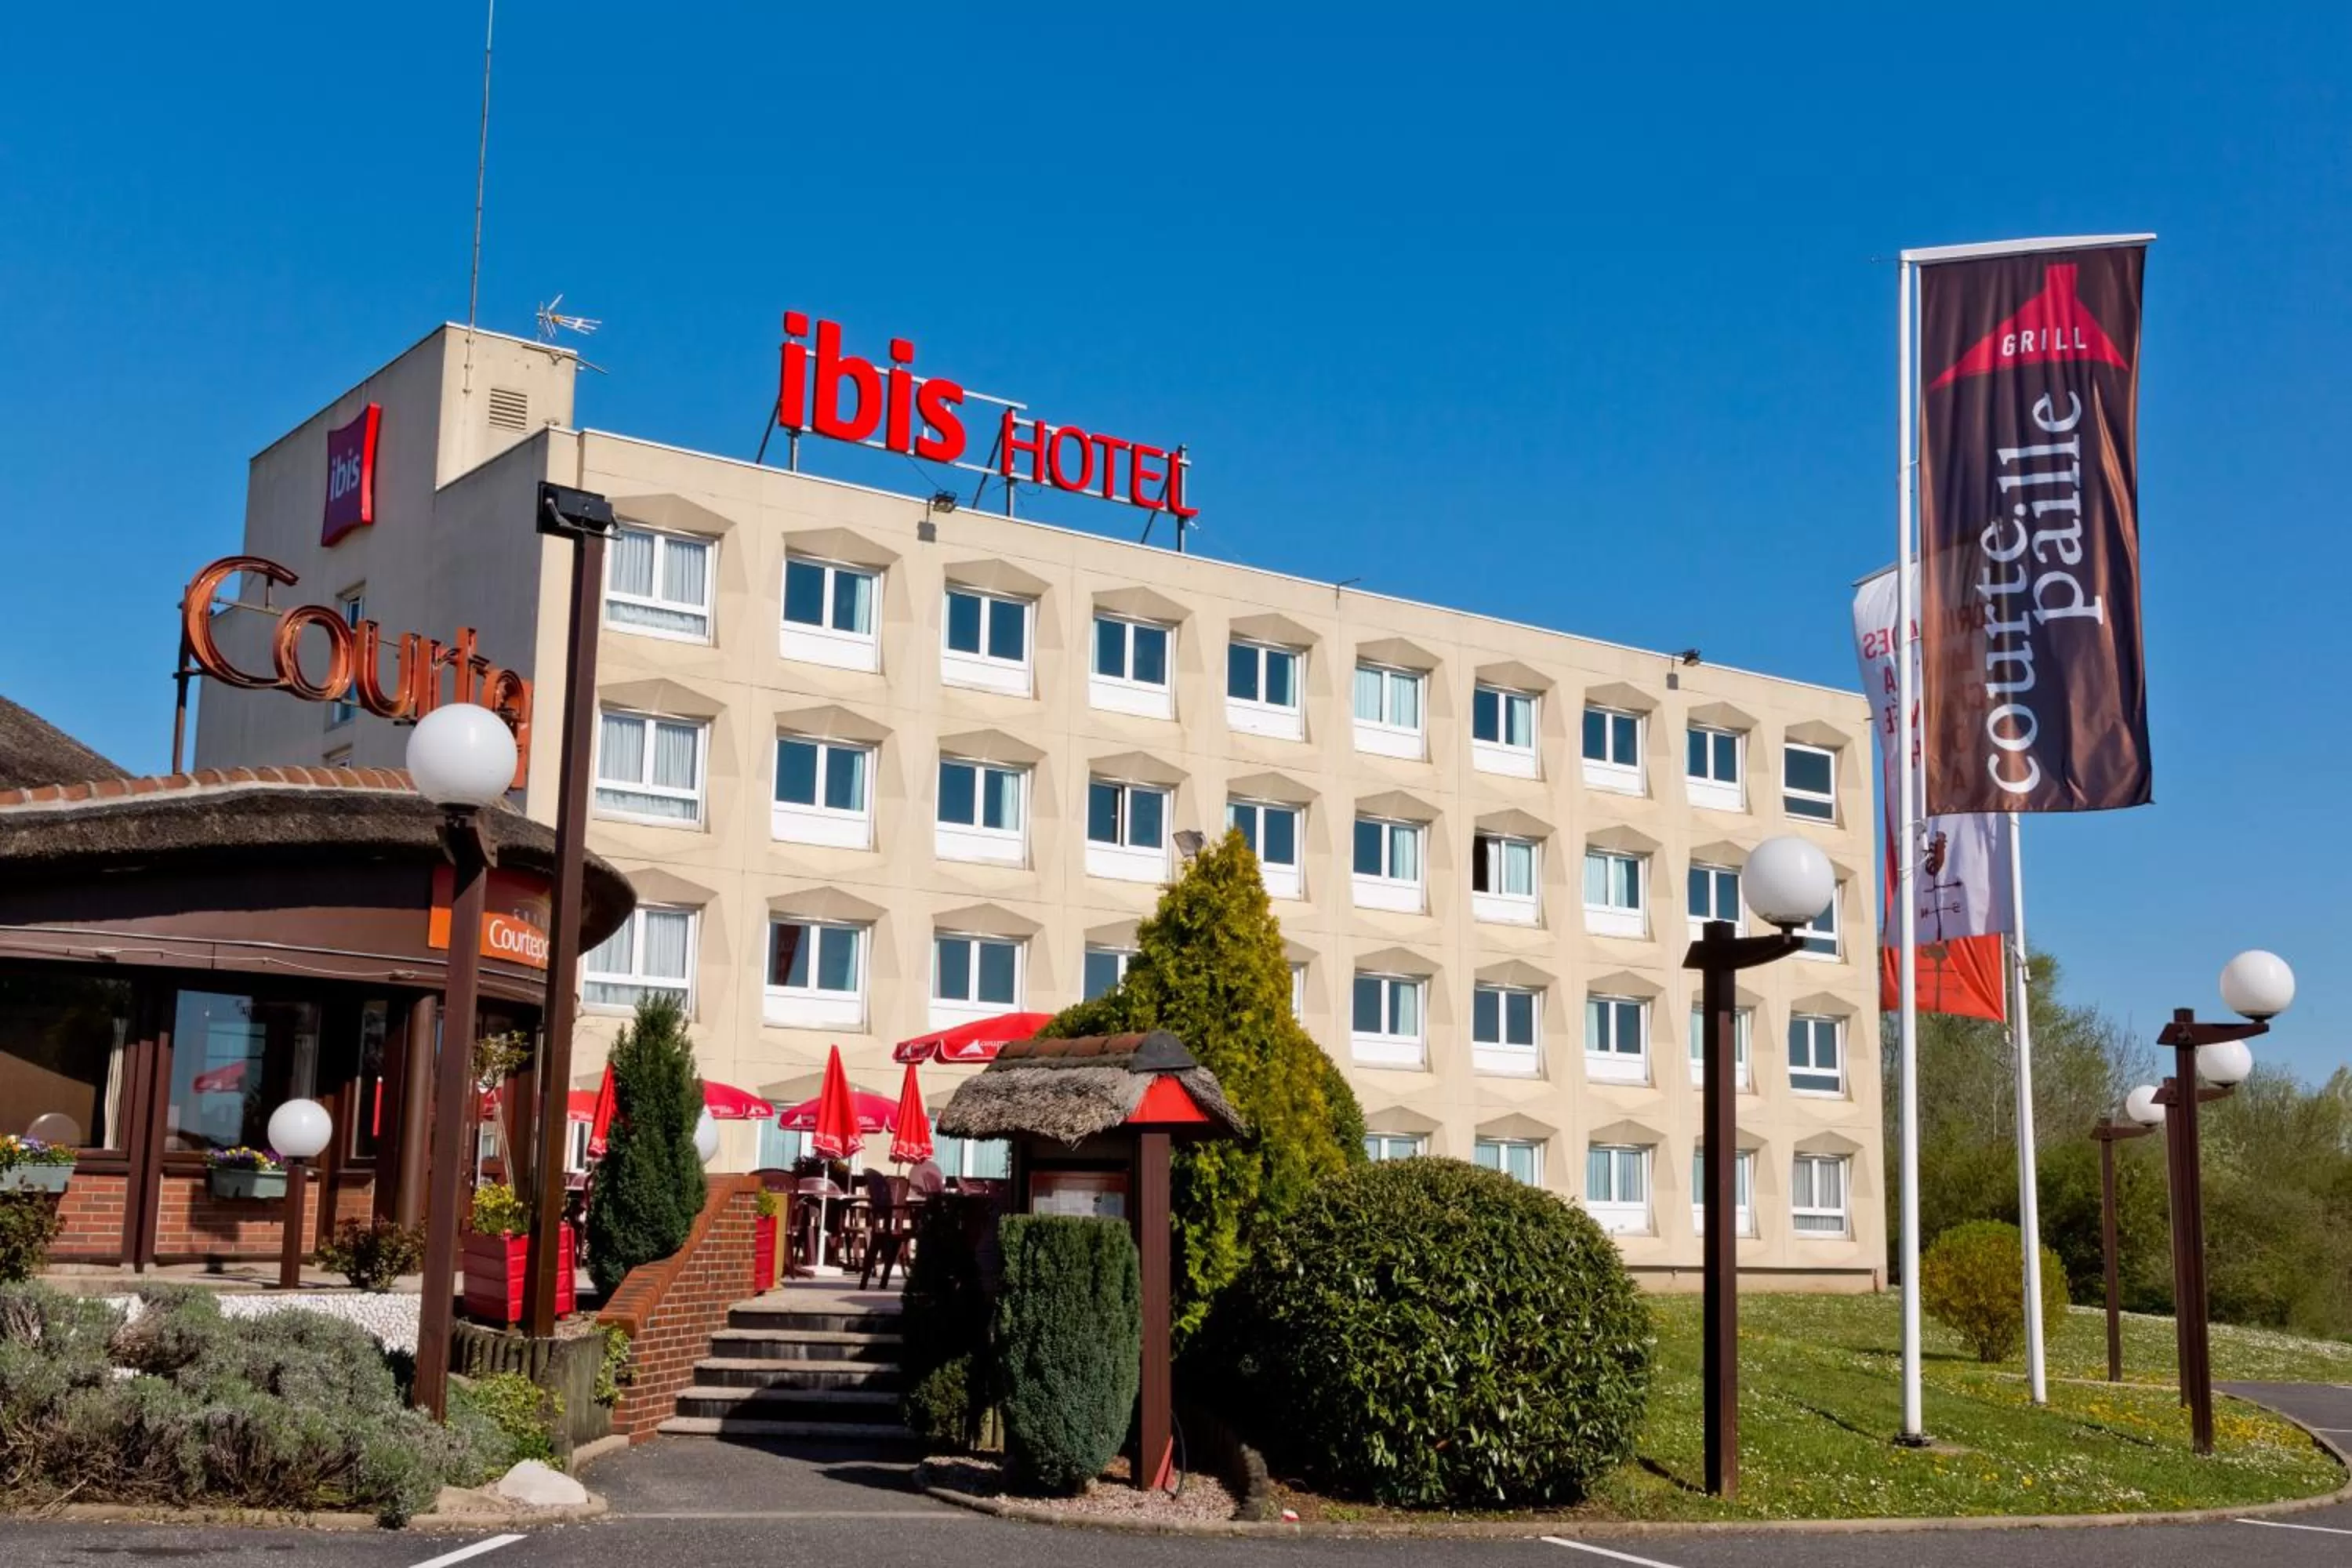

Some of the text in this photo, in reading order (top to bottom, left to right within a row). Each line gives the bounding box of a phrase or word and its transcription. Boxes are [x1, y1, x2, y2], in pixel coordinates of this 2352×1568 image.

[2002, 326, 2086, 357] GRILL
[329, 448, 360, 502] ibis
[779, 310, 1198, 517] ibis HOTEL
[1997, 391, 2103, 625] paille
